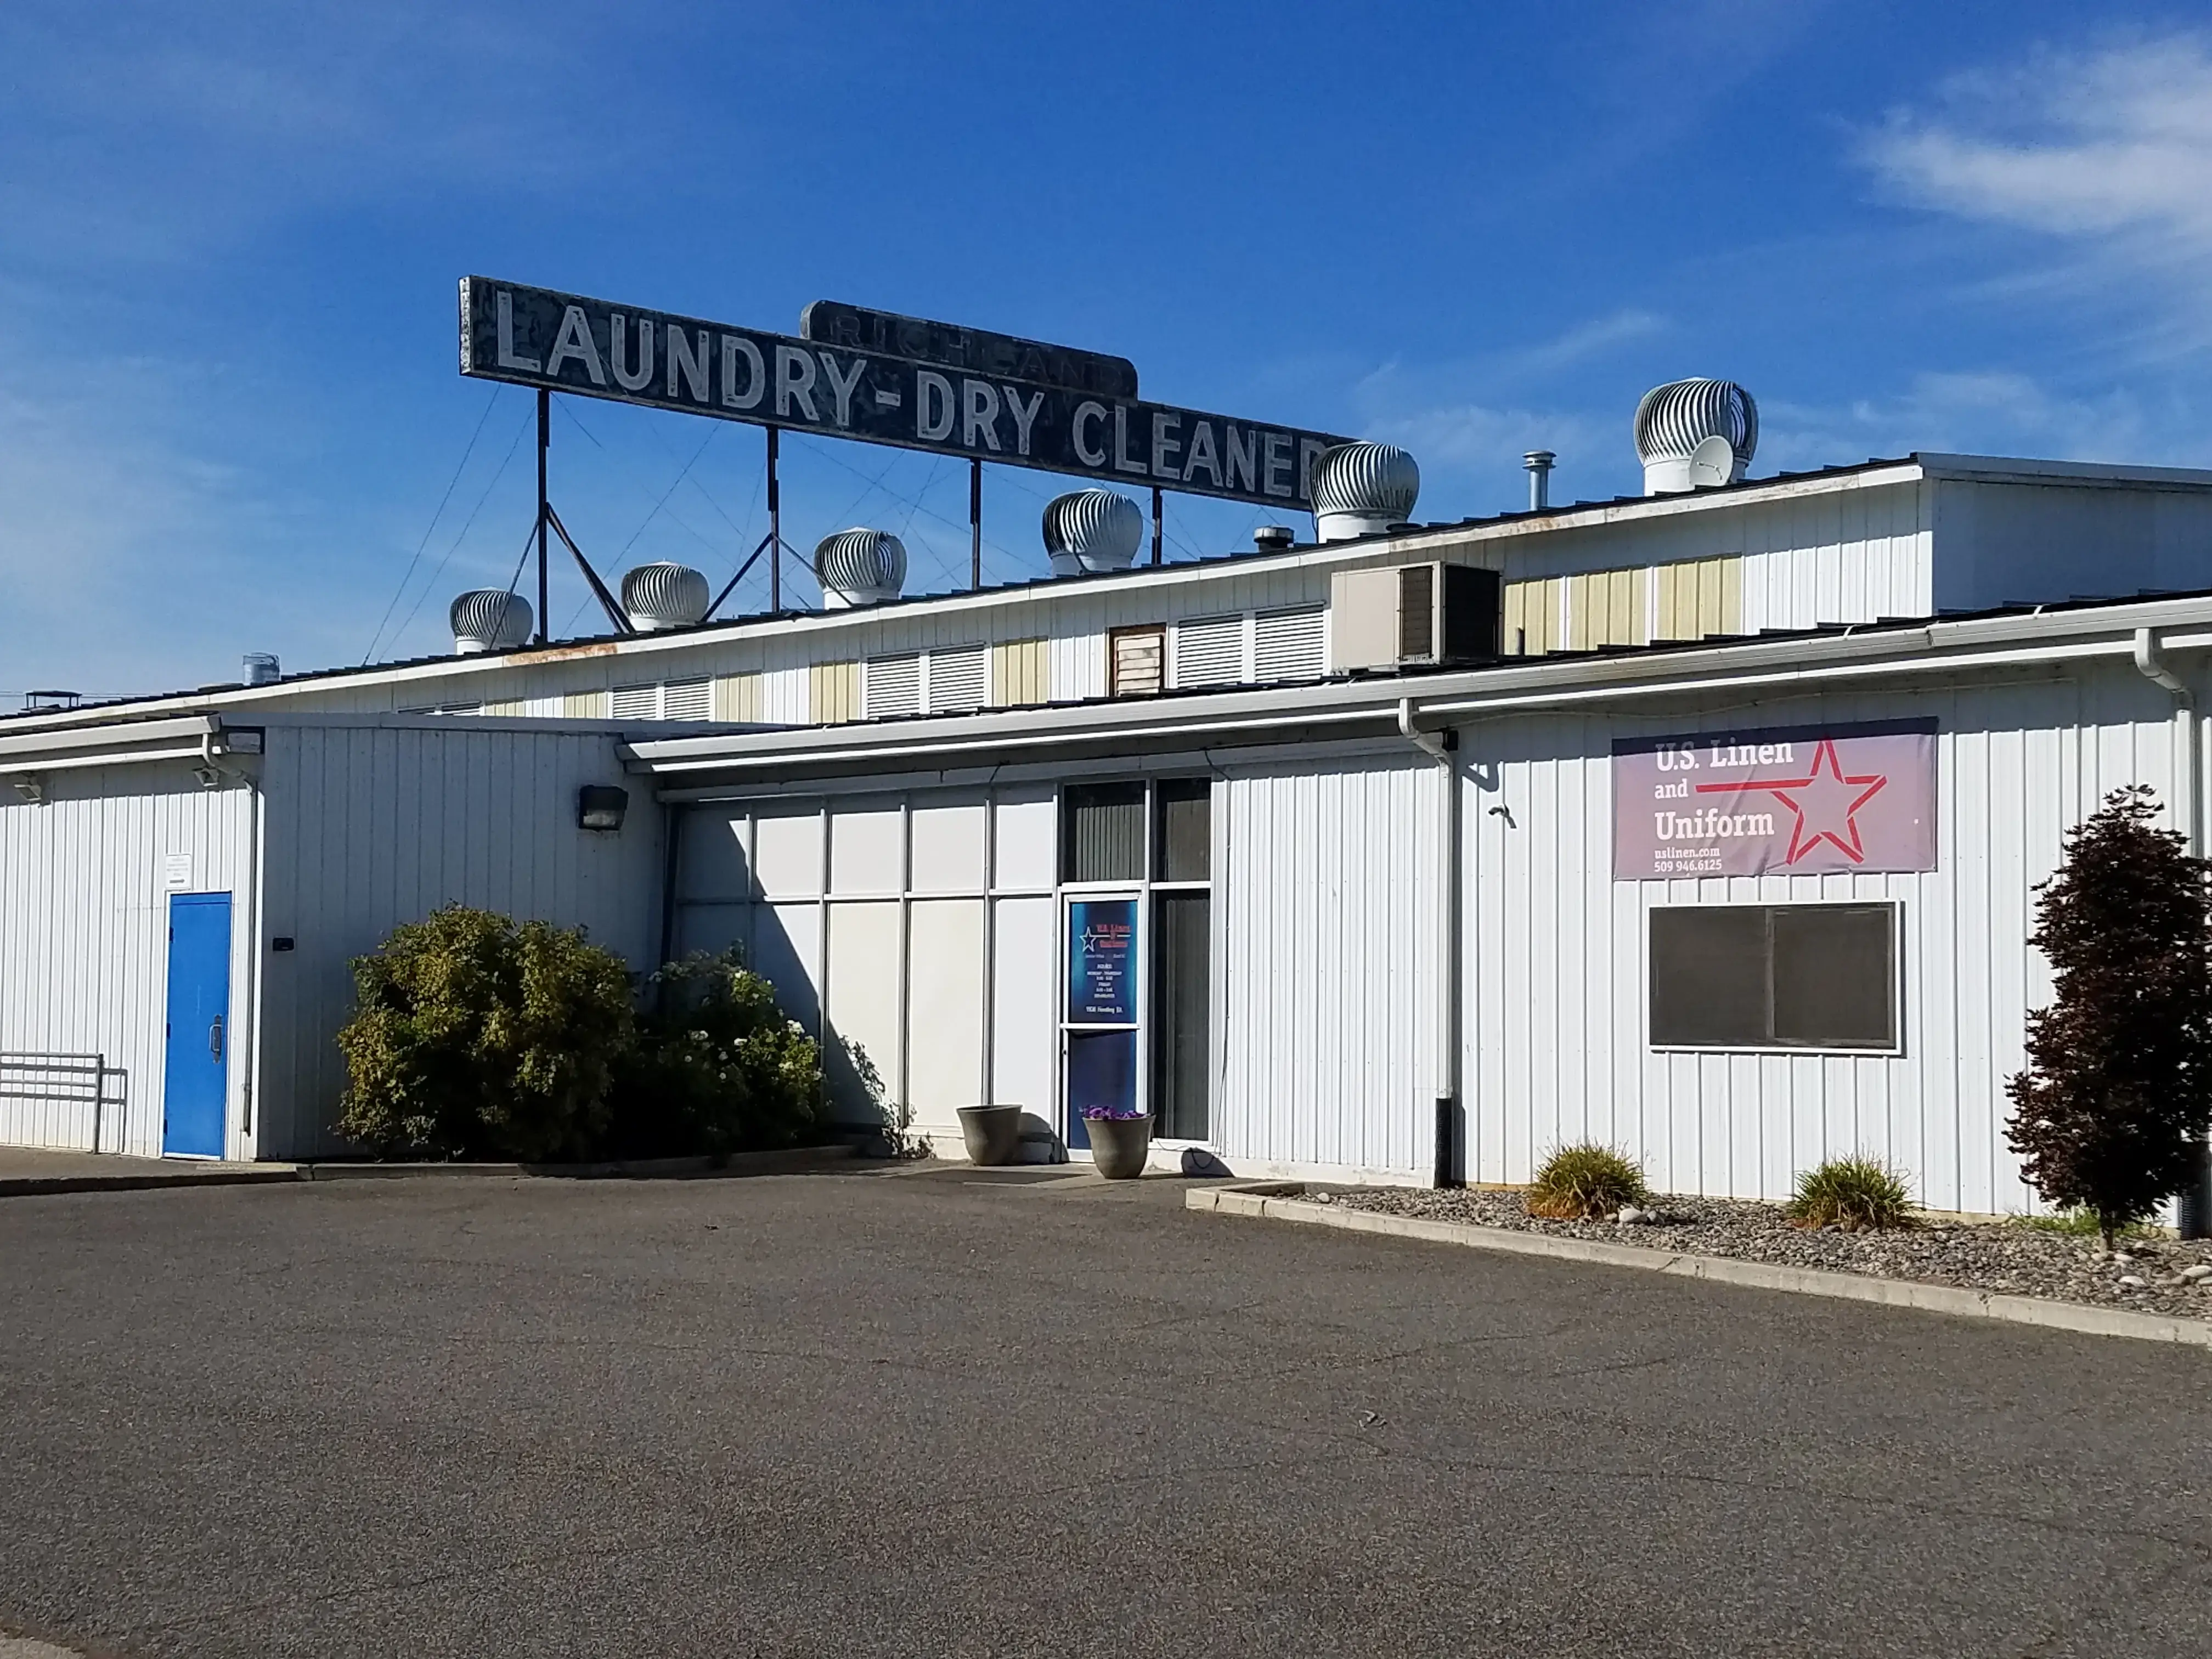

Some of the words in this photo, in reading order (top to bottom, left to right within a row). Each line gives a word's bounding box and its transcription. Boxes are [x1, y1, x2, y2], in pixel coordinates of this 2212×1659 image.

[1655, 741, 1700, 771] U.S.
[1709, 736, 1794, 768] Linen
[1655, 778, 1689, 799] and
[1654, 808, 1775, 840] Uniform
[1654, 847, 1720, 859] uslinen.com
[1654, 860, 1673, 872] 509
[1675, 859, 1722, 872] 946.6125
